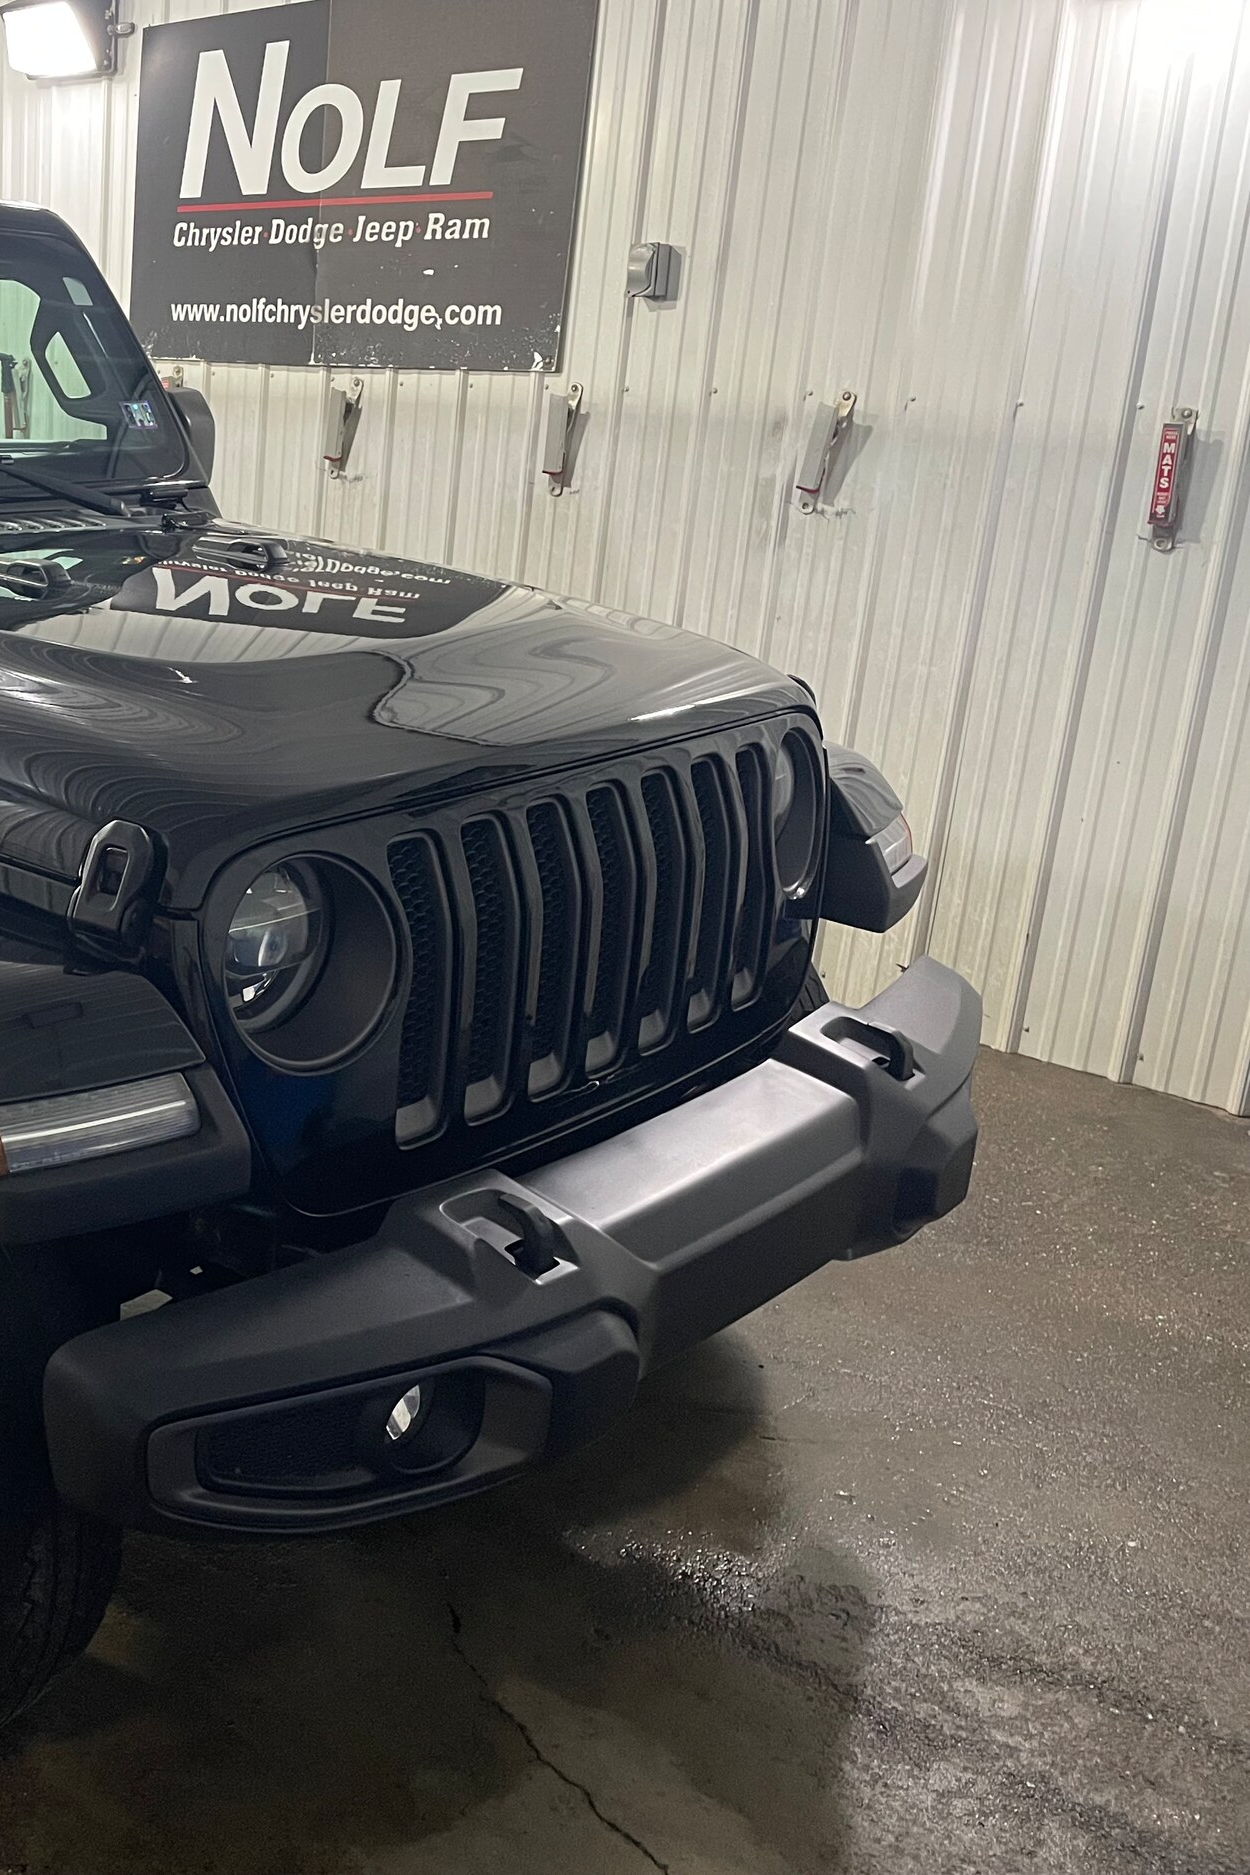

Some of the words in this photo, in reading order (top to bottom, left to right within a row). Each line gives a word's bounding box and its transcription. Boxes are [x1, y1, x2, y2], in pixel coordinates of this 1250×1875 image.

[173, 220, 263, 252] Chrysler
[269, 218, 344, 249] Dodge
[353, 215, 415, 247] Jeep
[424, 213, 490, 240] Ram
[171, 298, 502, 331] www.nolfchryslerdodge.com
[1158, 442, 1177, 489] MATS
